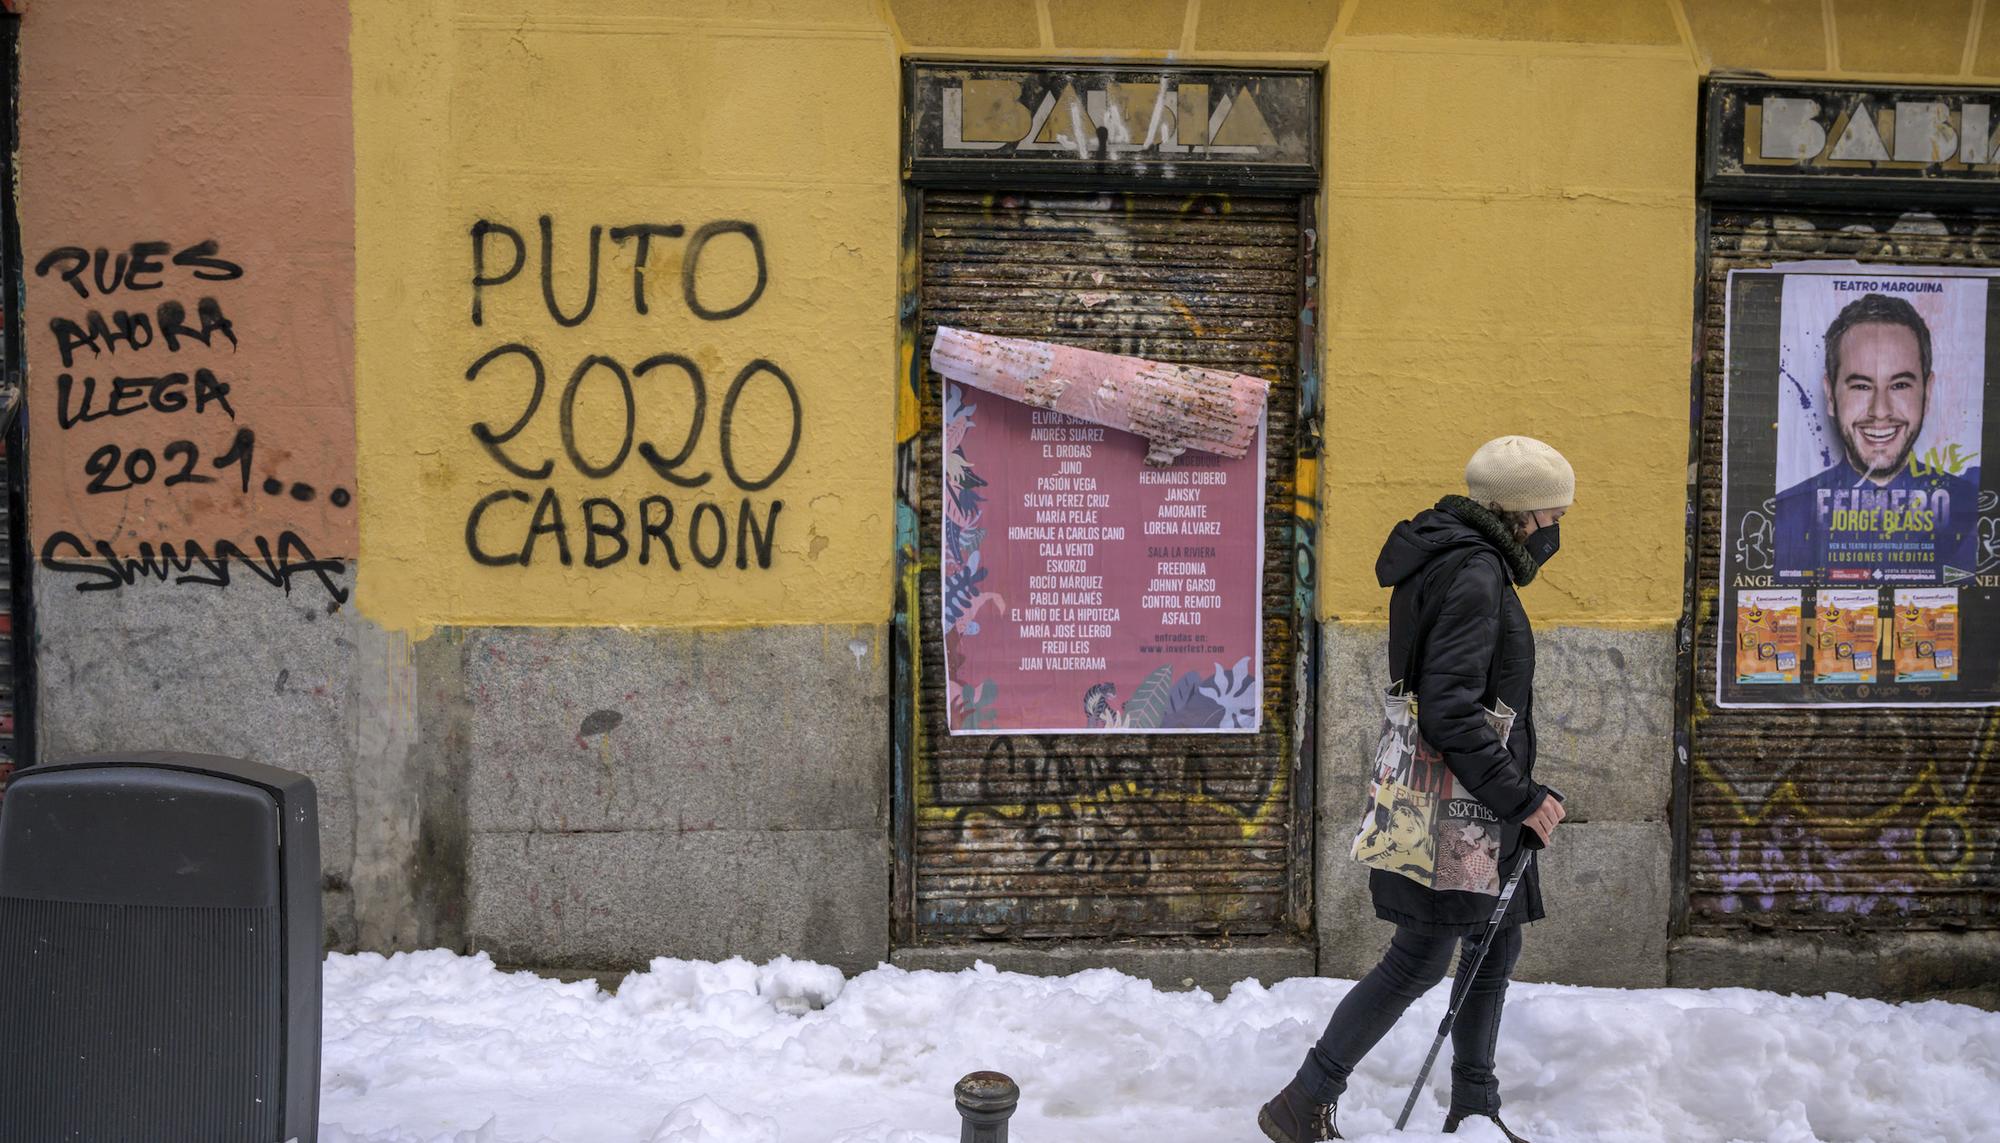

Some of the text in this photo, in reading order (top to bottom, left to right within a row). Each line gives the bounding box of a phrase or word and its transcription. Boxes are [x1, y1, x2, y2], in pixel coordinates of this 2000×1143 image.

[1744, 97, 2000, 170] BABI
[35, 240, 244, 298] PUES
[470, 214, 768, 327] PUTO
[1833, 280, 1943, 293] TEATRO MARQUINA
[50, 298, 238, 366] AHORA
[57, 368, 236, 430] LLEGA
[466, 344, 801, 492] 2020
[1032, 411, 1064, 425] ELVIRA
[1030, 427, 1105, 442] ANDRÉS SUÁREZ
[1043, 445, 1091, 458] EL DROGAS
[1908, 444, 1978, 478] LIVE
[1038, 476, 1097, 491] PASIÓN VEGA
[1140, 472, 1226, 485] HERMANOS CUBERO
[1057, 494, 1084, 507] PÉREZ
[1087, 494, 1109, 507] CRUZ
[1165, 488, 1200, 501] JANSKY
[1037, 510, 1066, 523] MARÍA
[1158, 505, 1206, 518] AMORANTE
[1144, 520, 1220, 534] LORENA ÁLVAREZ
[1830, 510, 1934, 532] JORGE BLASS
[465, 488, 782, 571] CABRON
[1009, 527, 1124, 540] HOMENAJE A CARLOS CANO
[1040, 543, 1093, 556] CALA VENTO
[1148, 547, 1215, 558] SALA LA RIVIERA
[1828, 550, 1935, 563] ILUSIONES INÉDITAS
[1047, 560, 1086, 572] ESKORZO
[1158, 562, 1206, 575] FREEDONIA
[1030, 575, 1103, 590] ROCÍO MÁRQUEZ
[1148, 579, 1215, 592] JOHNNY GARSO
[1030, 591, 1102, 605] PABLO MILANÉS
[1142, 595, 1221, 608] CONTROL REMOTO
[1012, 607, 1120, 621] EL NIÑO DE LA HIPOTECA
[1162, 612, 1200, 625] ASFALTO
[1021, 624, 1111, 638] MARÍA JOSÉ LLERGO
[1042, 641, 1089, 654] FREDI LEIS
[1019, 657, 1106, 670] JUAN VALDERRAMA
